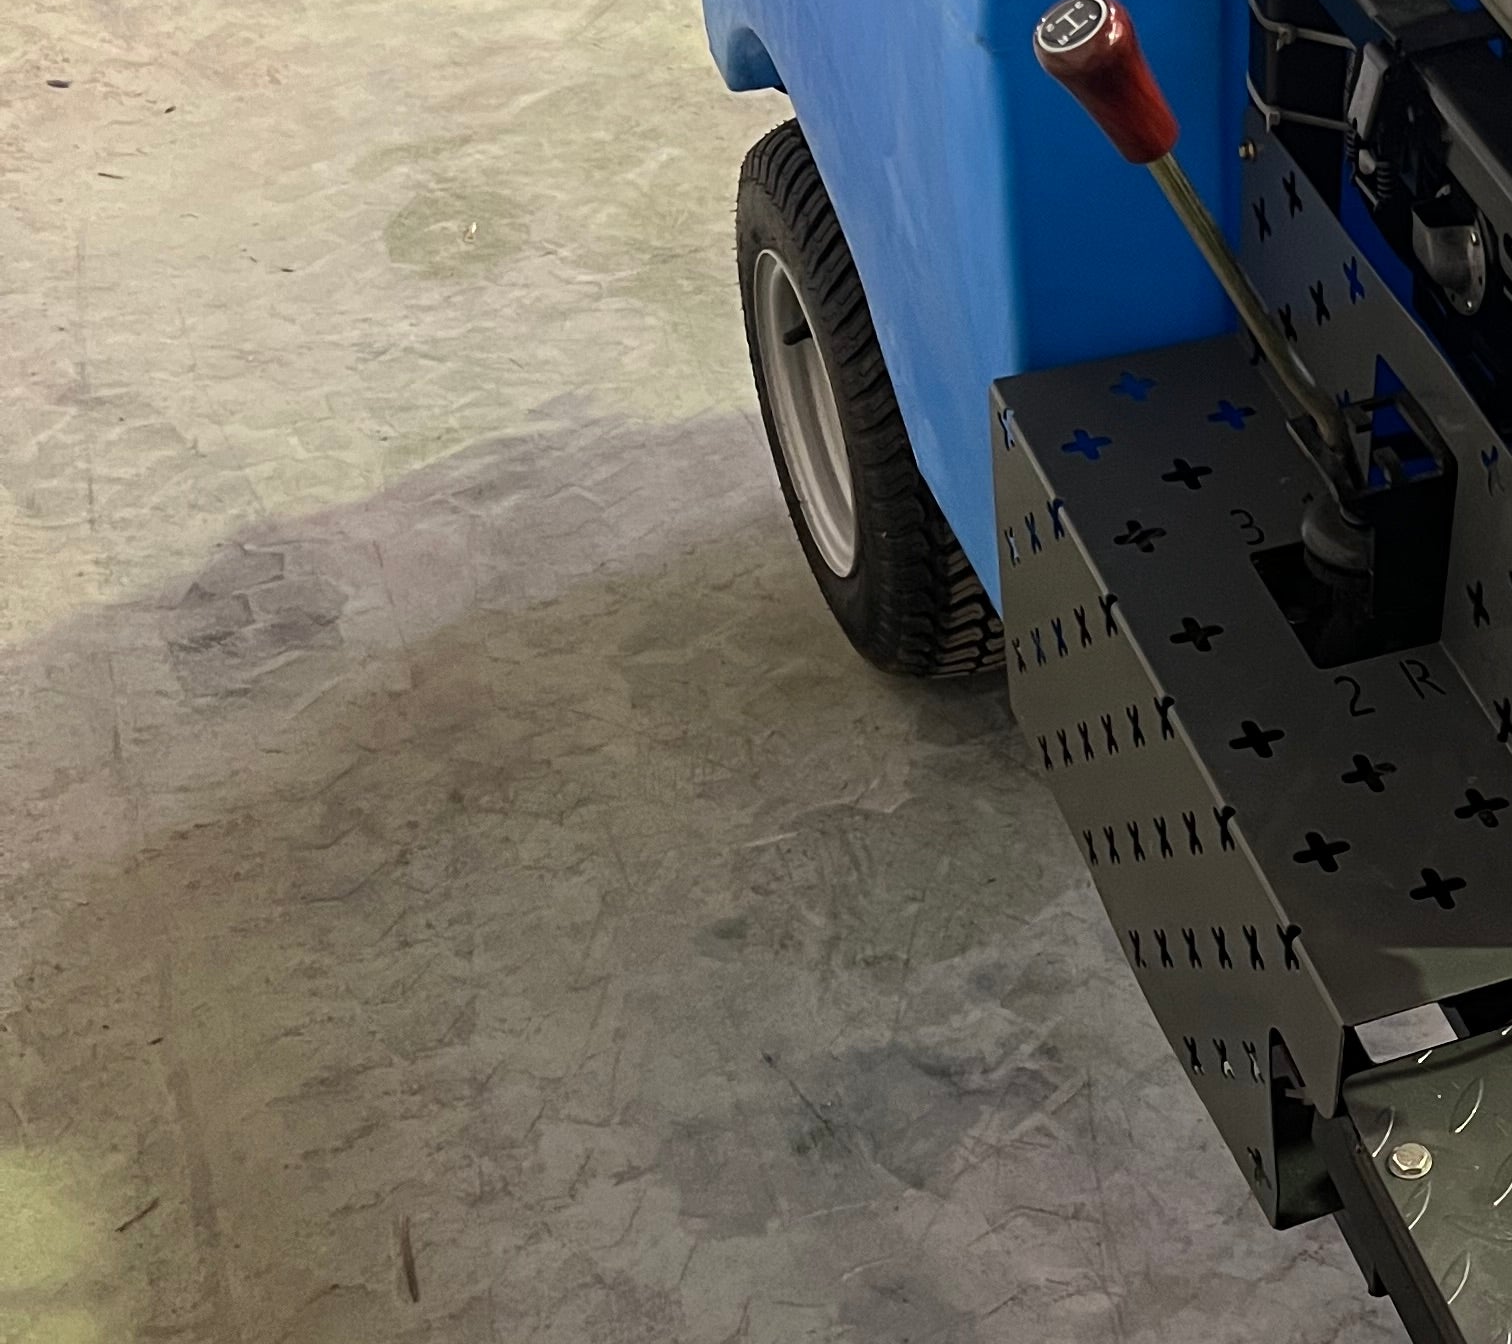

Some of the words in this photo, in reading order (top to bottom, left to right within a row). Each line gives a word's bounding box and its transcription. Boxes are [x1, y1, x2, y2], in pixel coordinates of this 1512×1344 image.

[1230, 509, 1265, 545] 3
[1334, 676, 1376, 717] 2
[1400, 659, 1447, 699] R
